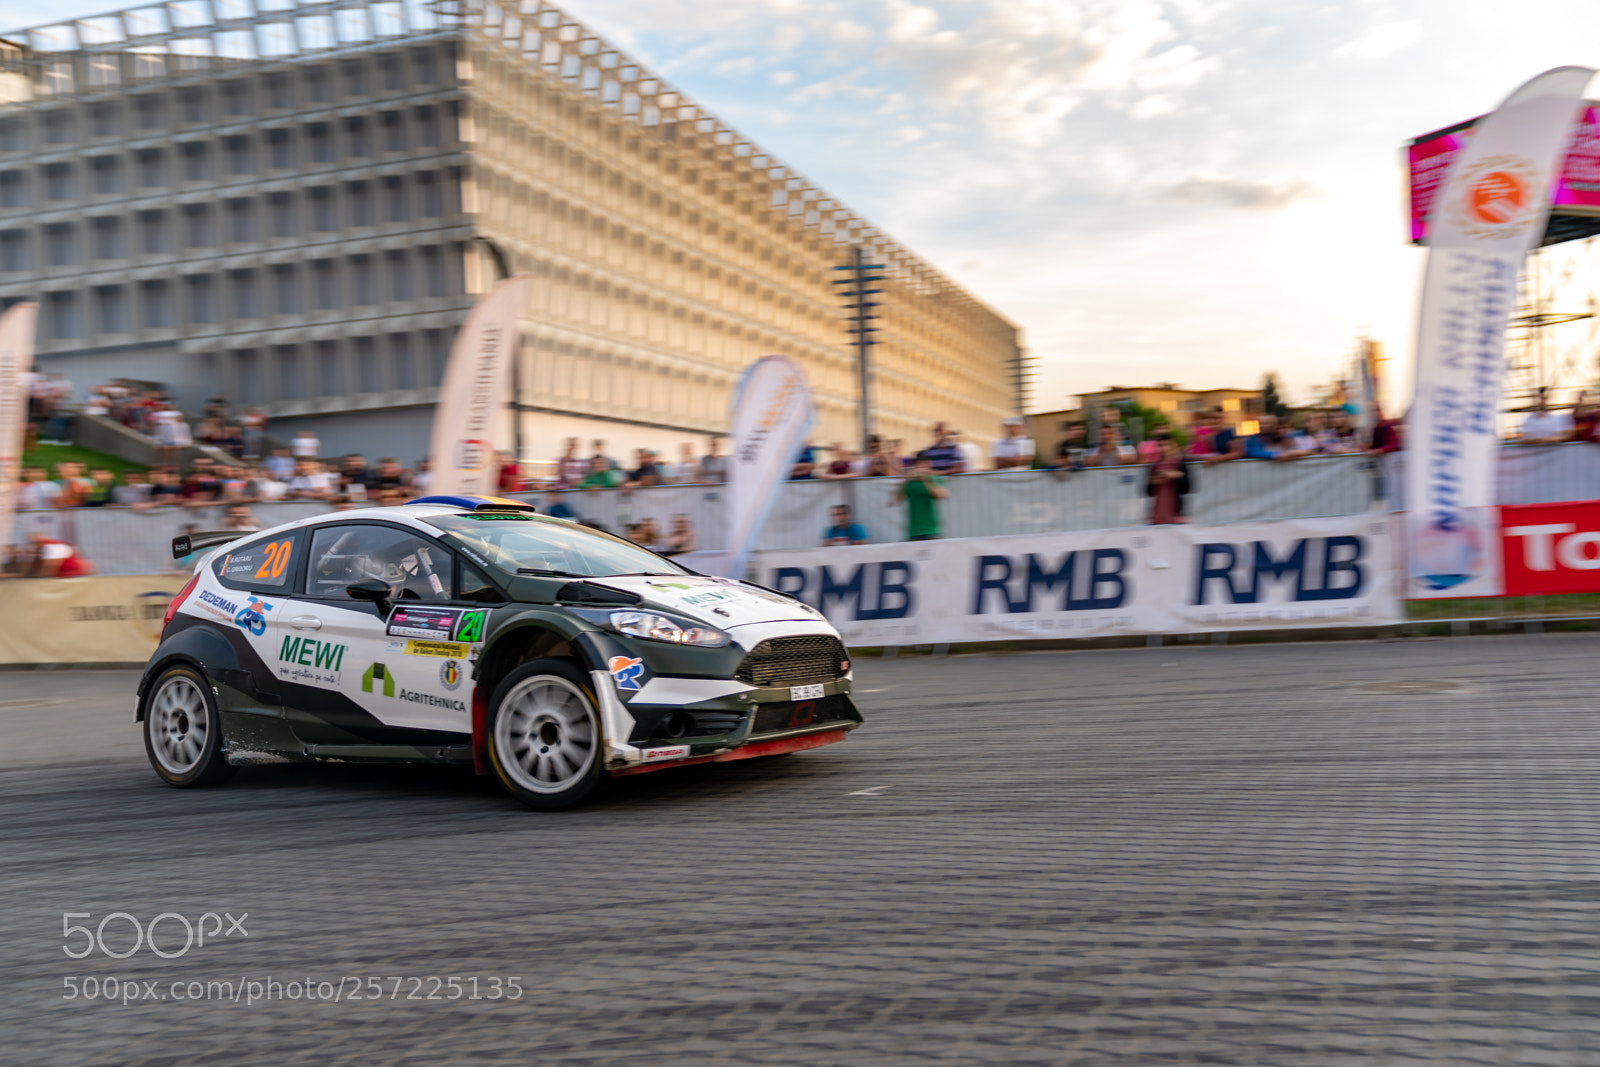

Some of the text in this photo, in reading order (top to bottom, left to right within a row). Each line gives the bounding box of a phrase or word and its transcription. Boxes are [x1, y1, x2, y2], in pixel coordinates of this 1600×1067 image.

[254, 540, 291, 579] 20
[1188, 535, 1369, 606] RMB
[680, 591, 737, 605] MEWI
[770, 561, 917, 620] RMB
[967, 548, 1135, 615] RMB
[198, 590, 238, 615] DEDEMAN
[456, 611, 486, 642] 20
[279, 635, 345, 672] MEWI
[399, 688, 466, 713] AGRITEHNICA
